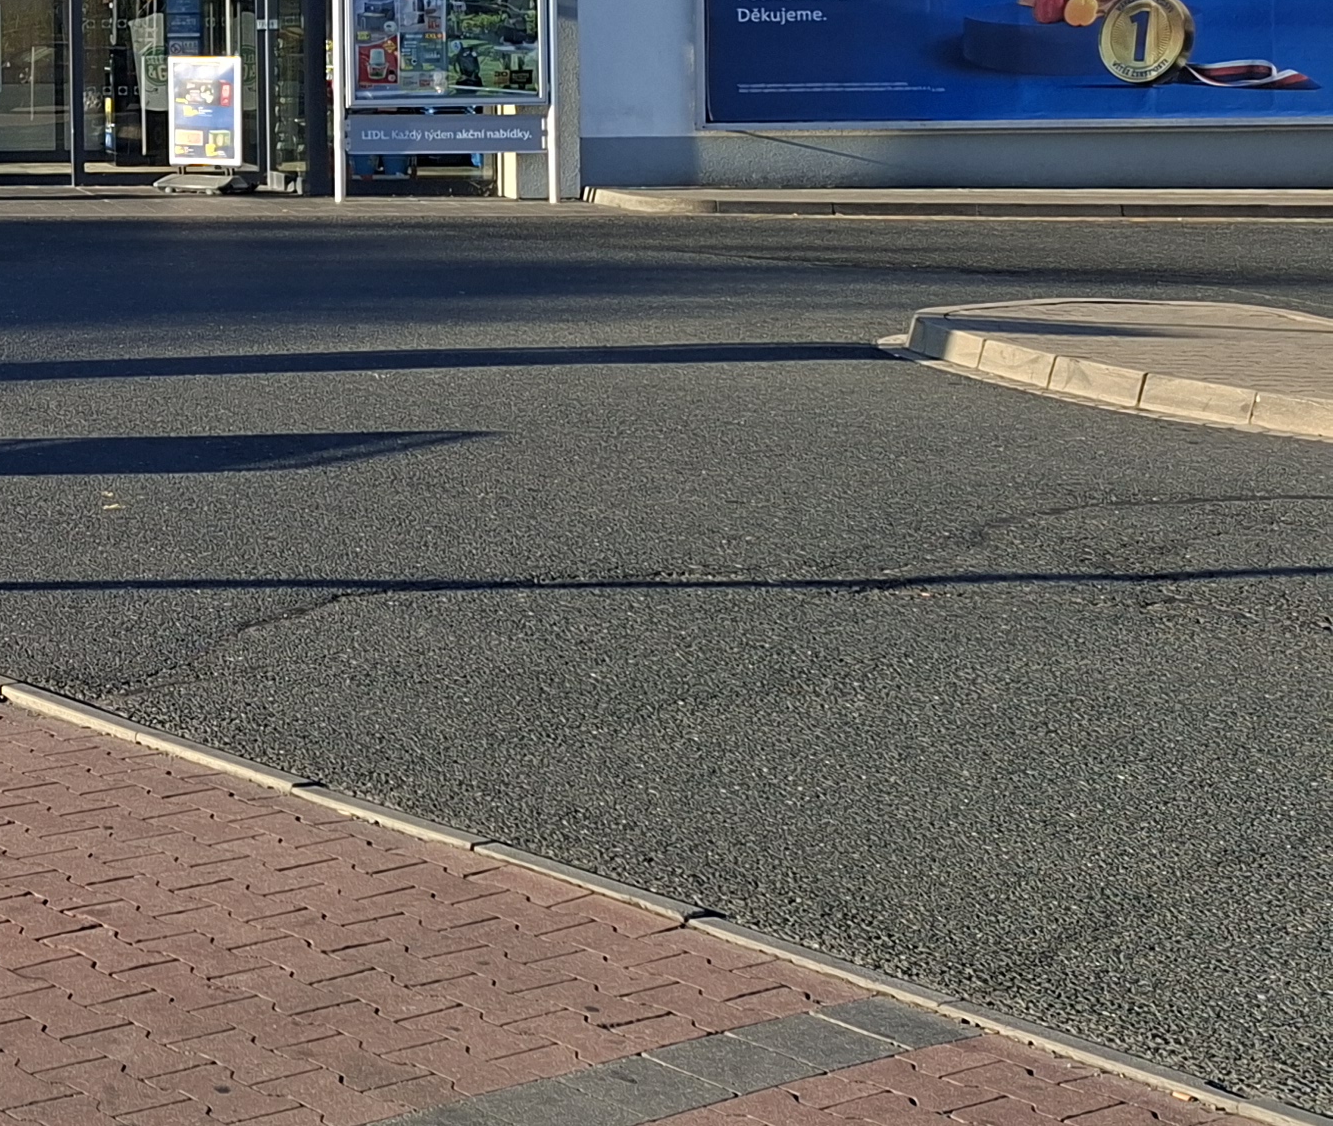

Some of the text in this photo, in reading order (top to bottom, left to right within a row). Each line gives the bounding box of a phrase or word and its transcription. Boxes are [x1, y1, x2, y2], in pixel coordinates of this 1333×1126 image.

[737, 8, 827, 25] Děkujeme.
[391, 129, 422, 142] Každý
[424, 128, 454, 141] týden
[456, 128, 485, 140] akční
[486, 128, 533, 141] nabídky.
